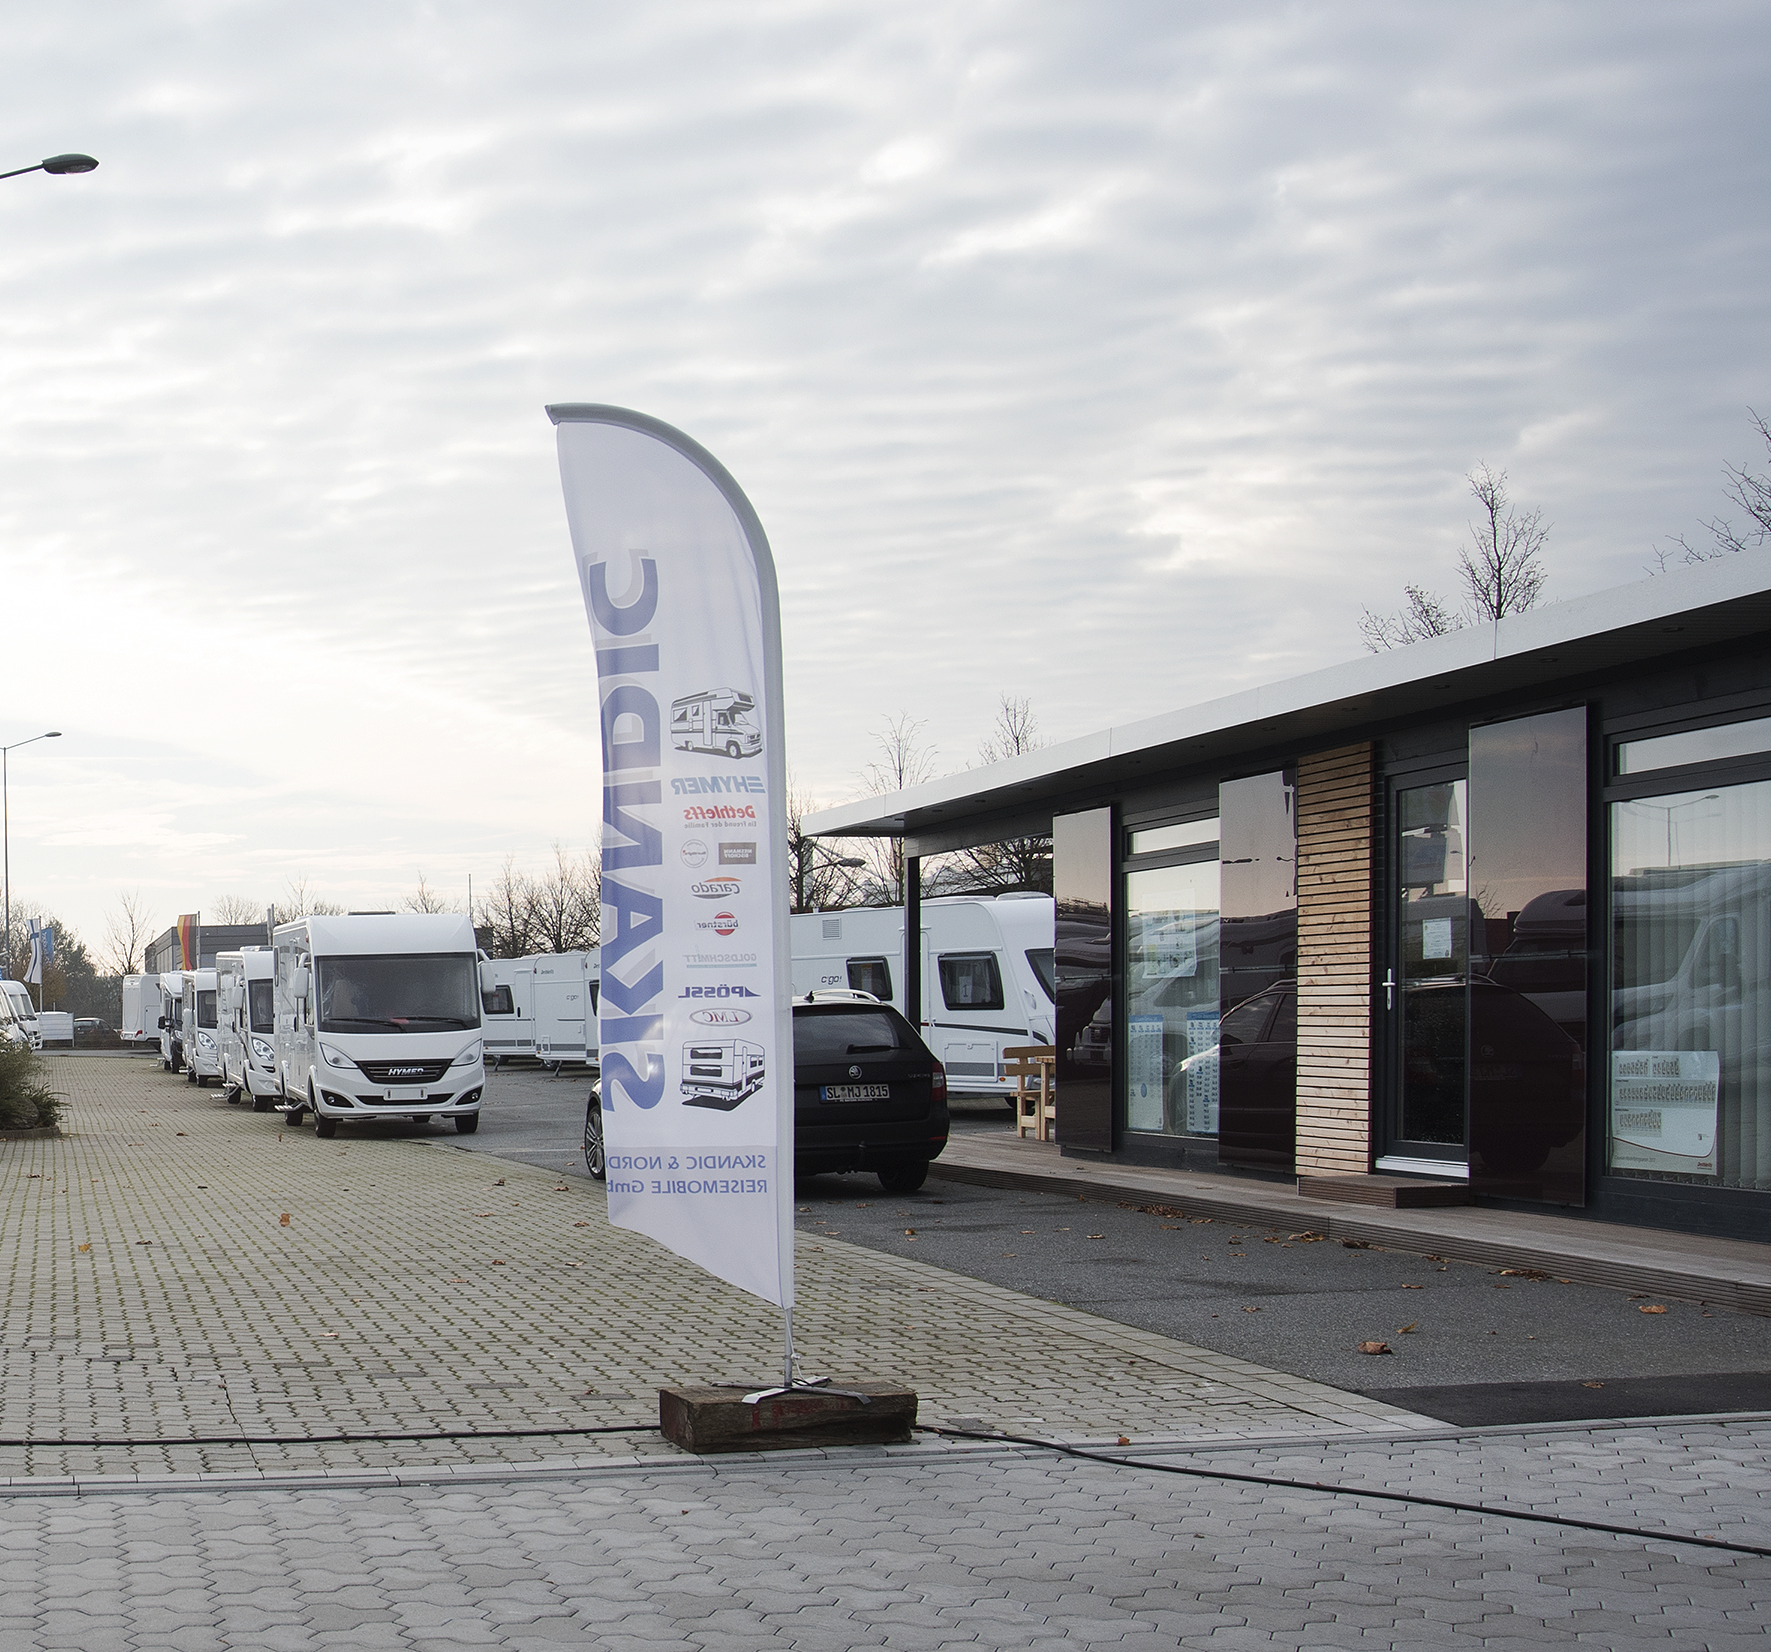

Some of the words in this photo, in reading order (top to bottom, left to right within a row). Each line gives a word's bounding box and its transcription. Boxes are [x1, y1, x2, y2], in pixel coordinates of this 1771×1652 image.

[827, 1087, 841, 1099] SL
[847, 1086, 862, 1098] MJ
[863, 1085, 888, 1098] 1815
